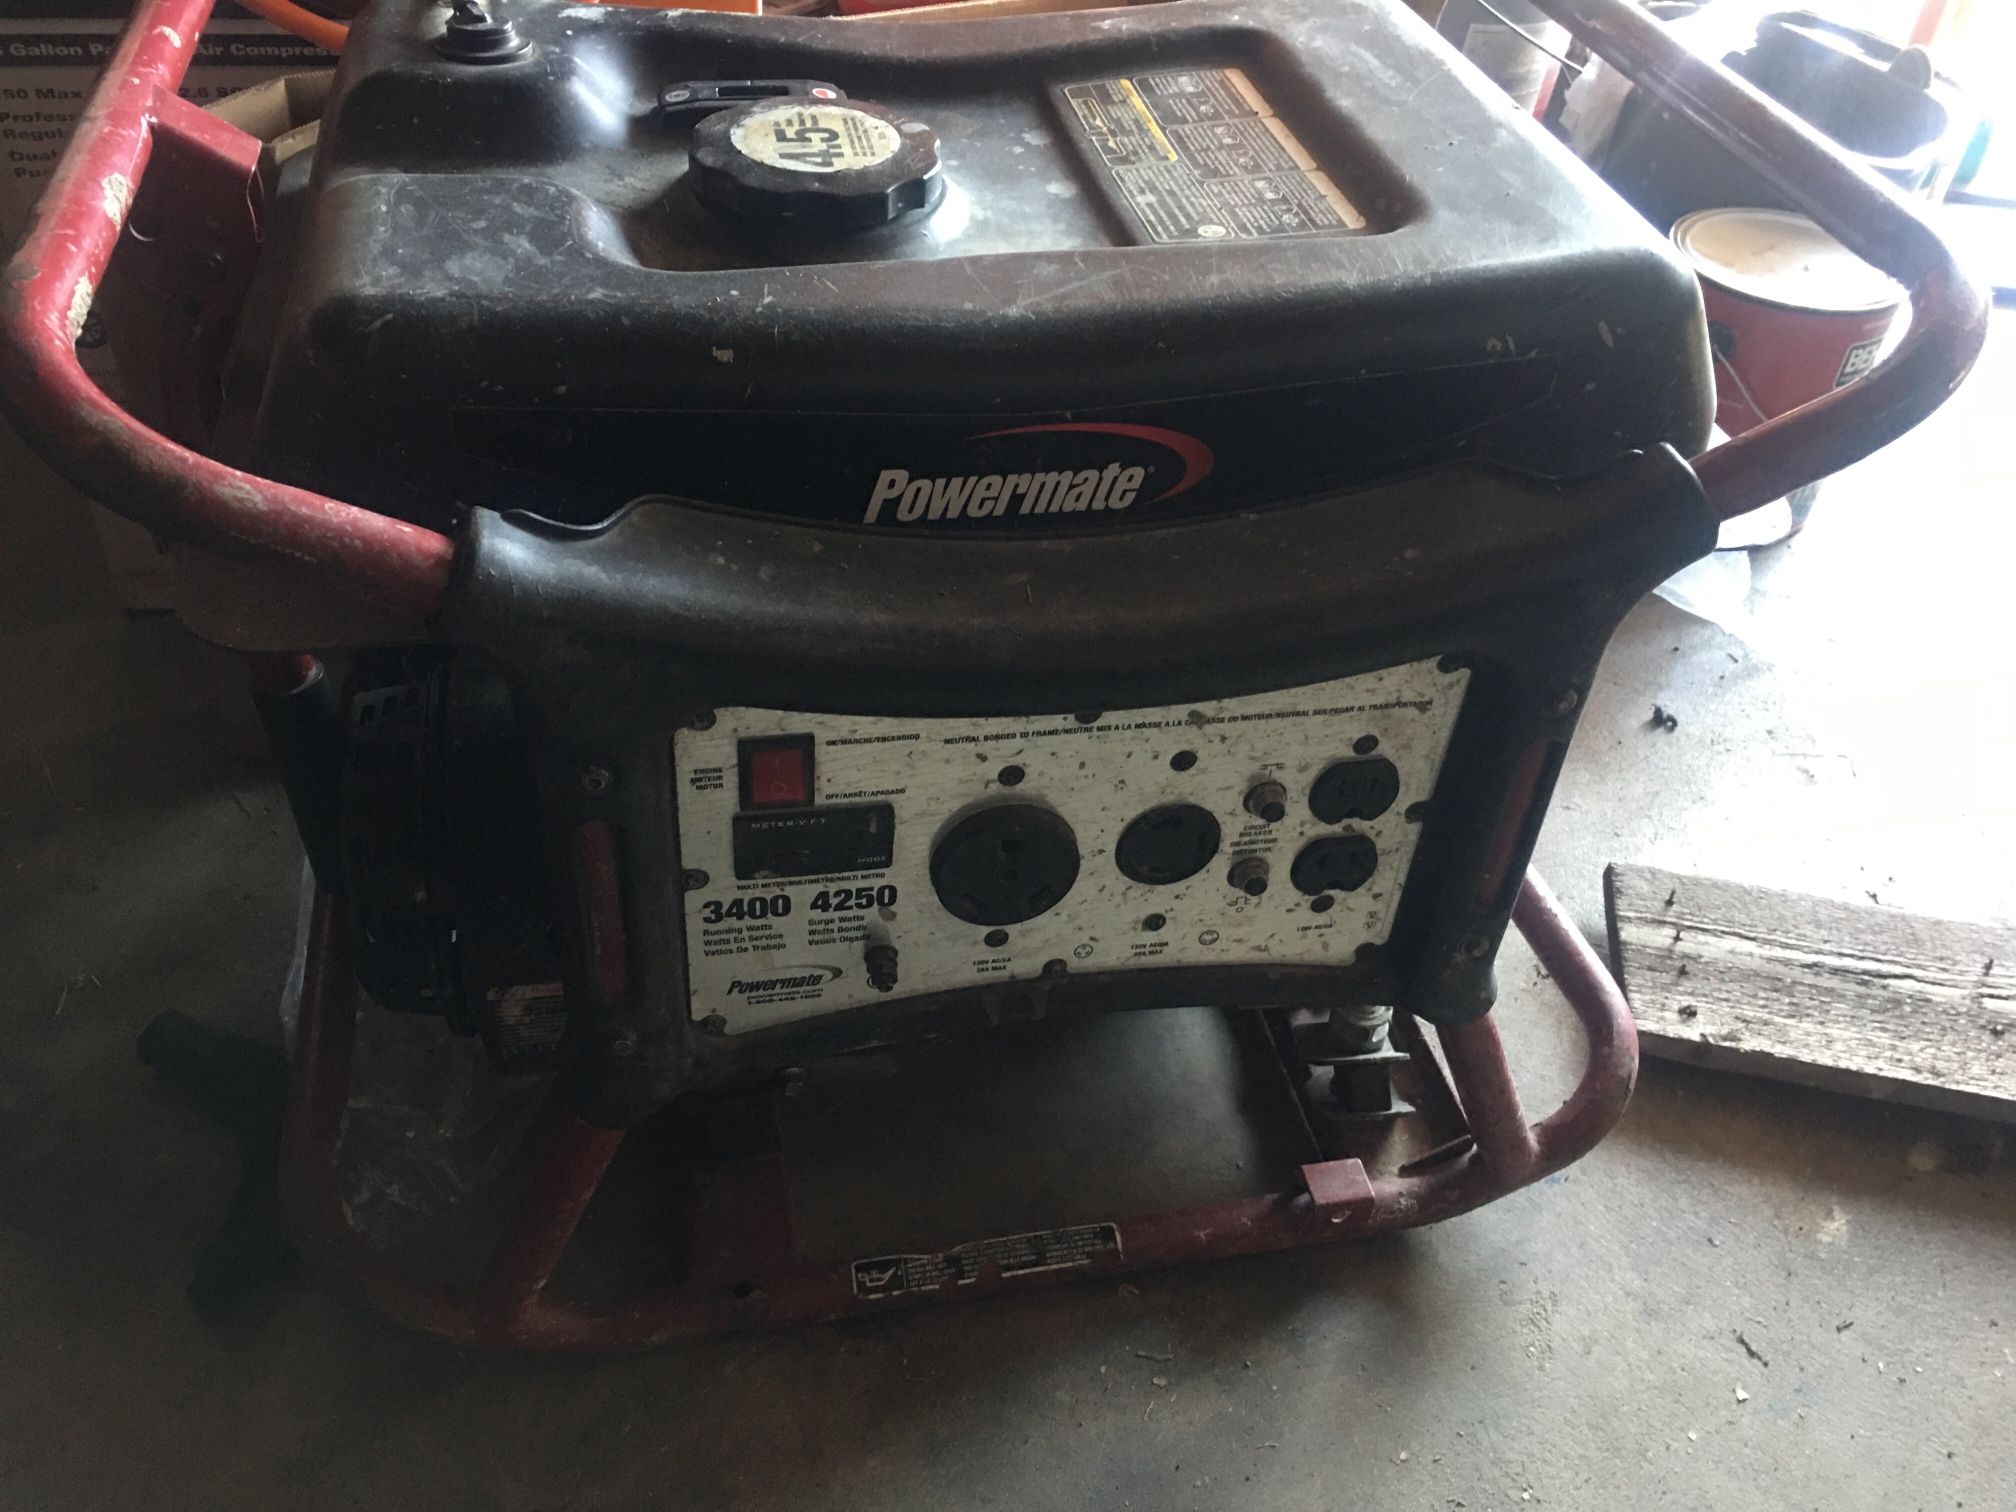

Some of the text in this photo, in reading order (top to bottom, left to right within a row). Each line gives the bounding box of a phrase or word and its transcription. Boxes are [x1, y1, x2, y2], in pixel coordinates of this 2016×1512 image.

[9, 42, 83, 57] Gallon
[197, 43, 223, 56] Air
[35, 88, 82, 99] Max
[863, 462, 1145, 525] Powermate
[944, 735, 980, 745] NEUTRAL
[984, 732, 1016, 742] BONDED
[1032, 726, 1093, 738] FRAME/NEUTRE
[1096, 724, 1111, 732] MIS
[1134, 720, 1161, 729] MASSE
[1240, 710, 1309, 721] MOTEUR/NEUTRAL
[826, 733, 920, 747] ON/MARCHE/ENCENDIDO
[694, 767, 723, 776] ENGINE
[690, 775, 723, 784] MOTEUR
[825, 788, 905, 801] OFF/ARRÊT/APAGADO
[1239, 830, 1272, 838] BREAKER
[1243, 823, 1270, 831] CIRCUIT
[737, 883, 759, 891] MULTI
[861, 872, 885, 881] METRO
[810, 885, 897, 912] 4250
[702, 894, 791, 924] 3400
[808, 914, 865, 926] Surge Watts
[703, 923, 773, 938] Running Watts
[808, 928, 835, 936] Watts
[704, 938, 731, 947] Watts
[748, 932, 784, 942] Service
[704, 941, 786, 957] Vatios De Trabajo
[727, 973, 825, 996] Powermate
